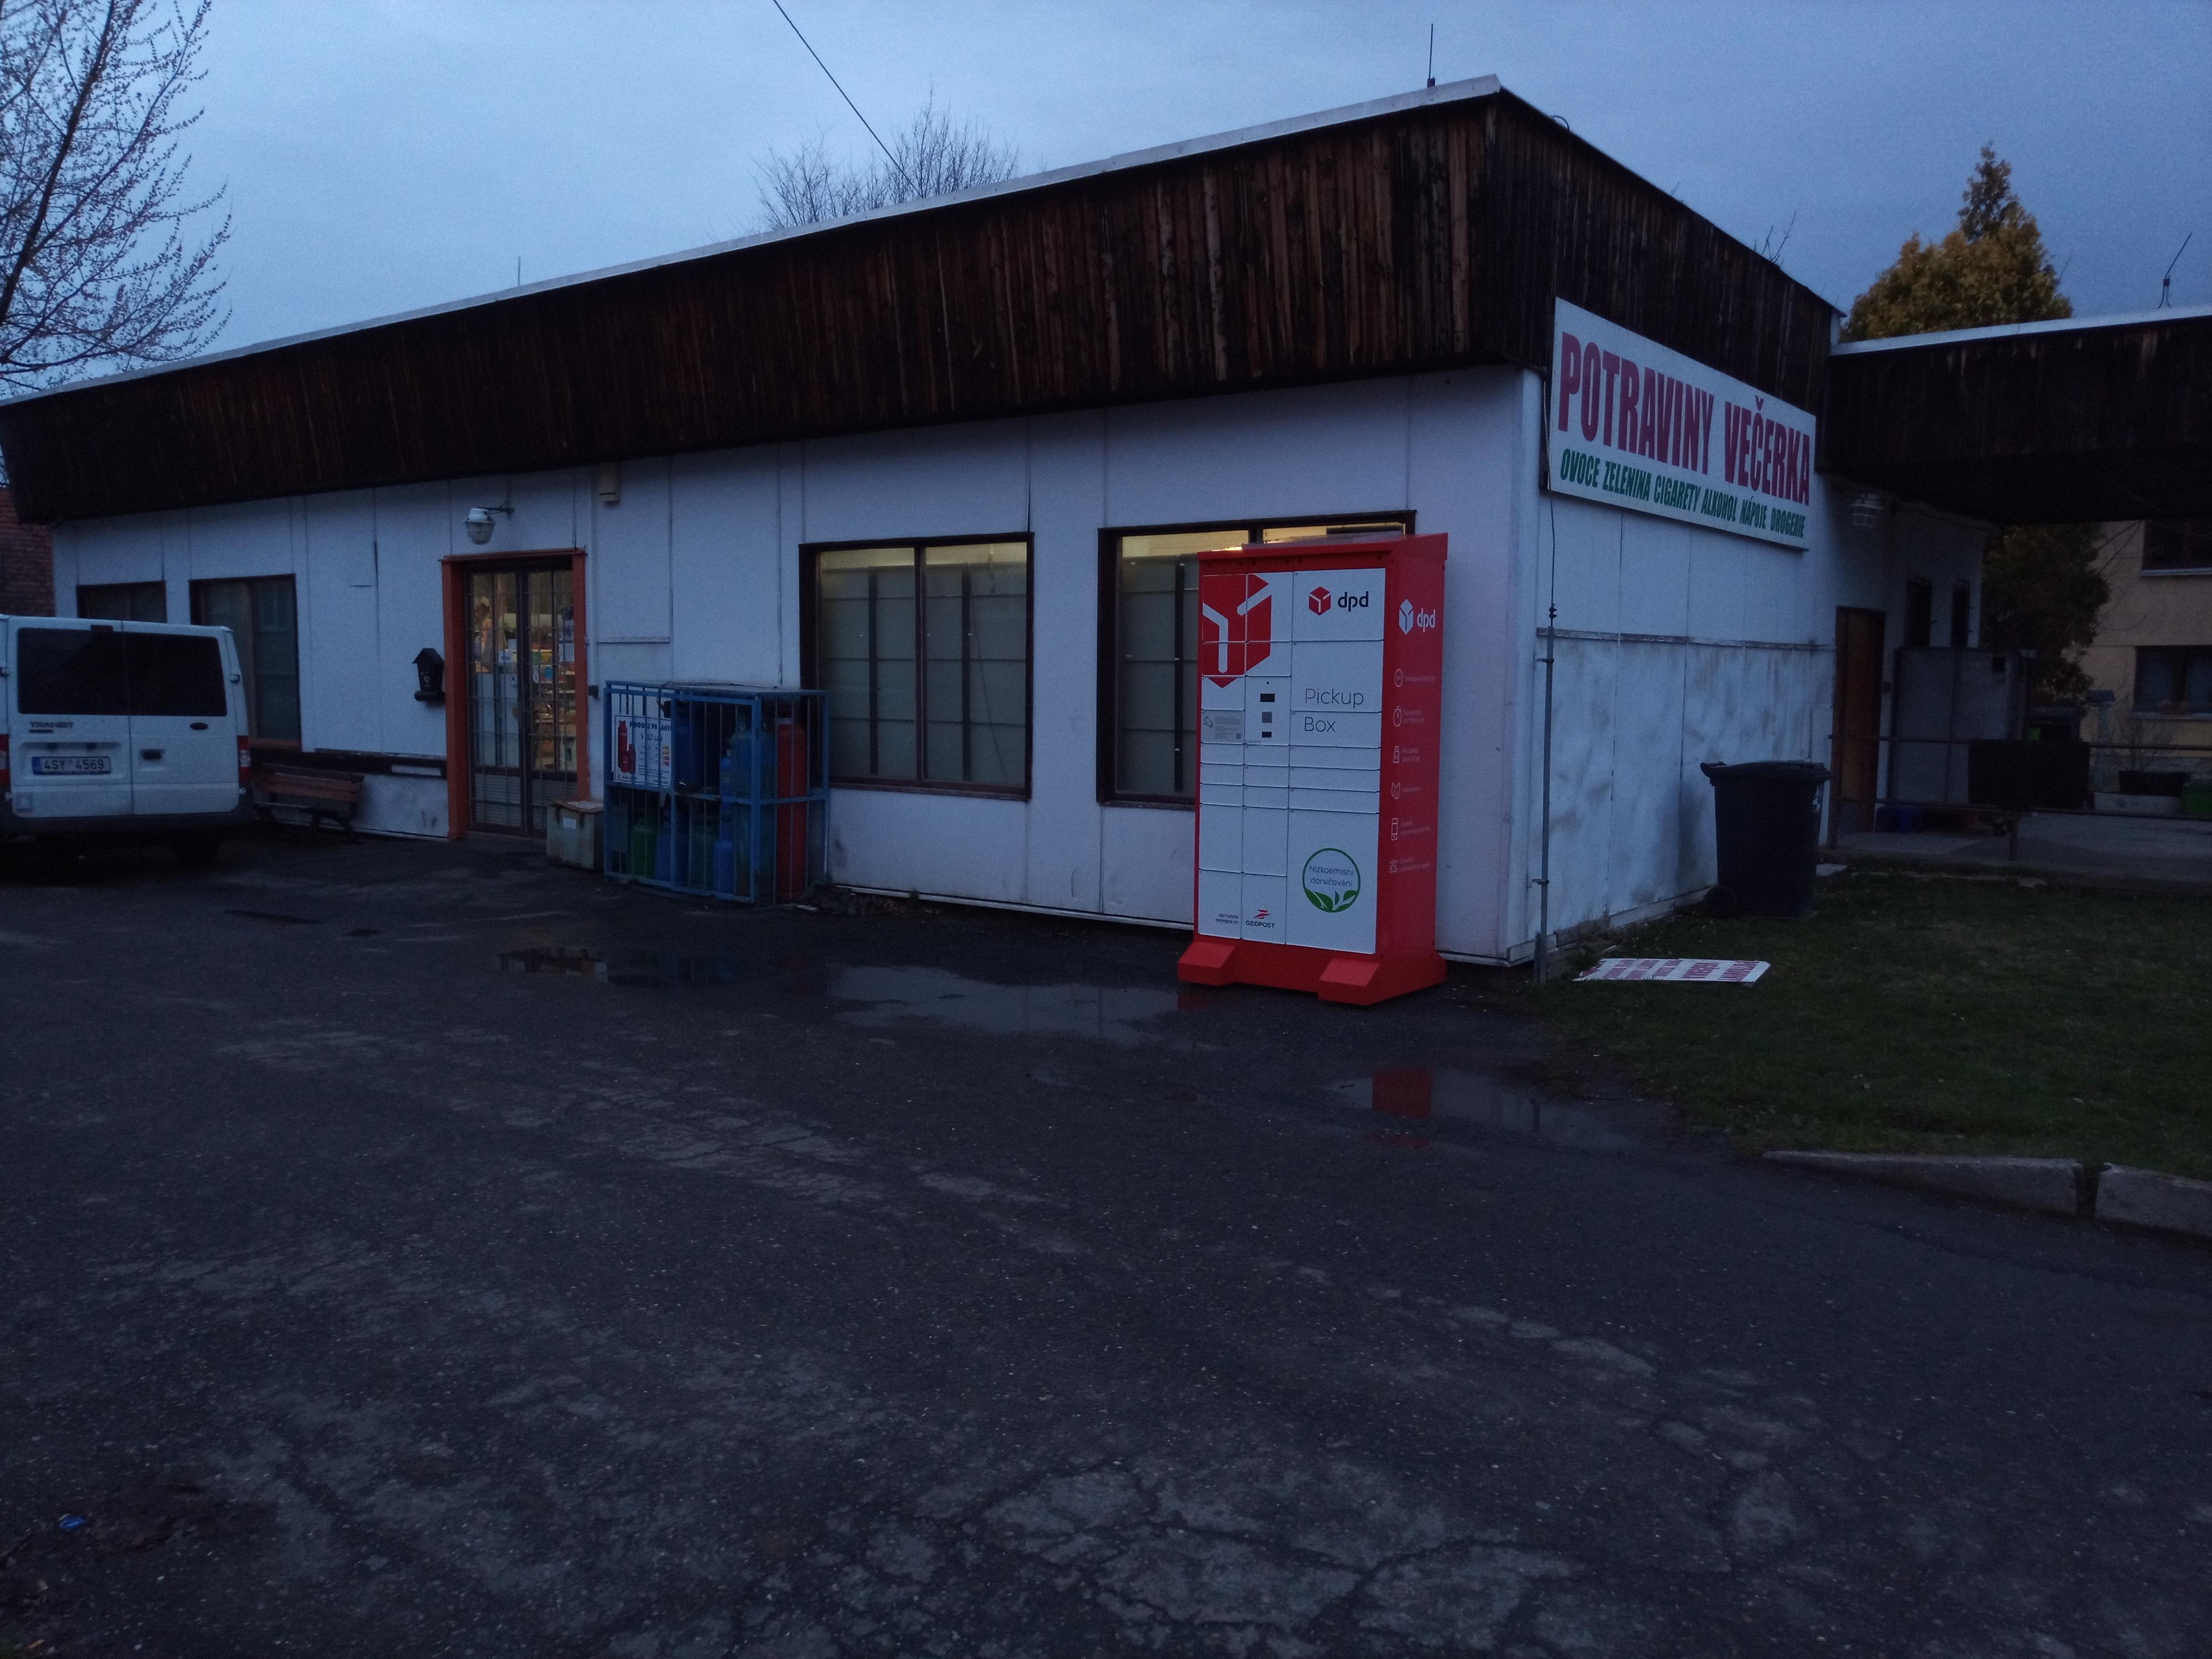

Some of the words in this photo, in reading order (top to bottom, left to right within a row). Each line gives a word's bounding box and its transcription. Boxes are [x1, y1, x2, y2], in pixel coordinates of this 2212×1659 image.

[1558, 332, 1714, 474] POTRAVINY
[1724, 395, 1809, 505] VEČERKA
[1560, 448, 1600, 488] OVOCE
[1602, 460, 1651, 501] ZELENINA
[1653, 474, 1701, 512] CIGARETY
[1700, 488, 1738, 522] ALKOHOL
[1739, 495, 1767, 529] NÁPOJE
[1770, 507, 1806, 538] DROGERIE
[1338, 591, 1369, 612] dpd
[1417, 608, 1436, 633] dpd
[1305, 688, 1364, 708] Pickup
[1305, 717, 1335, 732] Box
[44, 760, 65, 770] 4SY
[1245, 920, 1275, 928] GEOPOST
